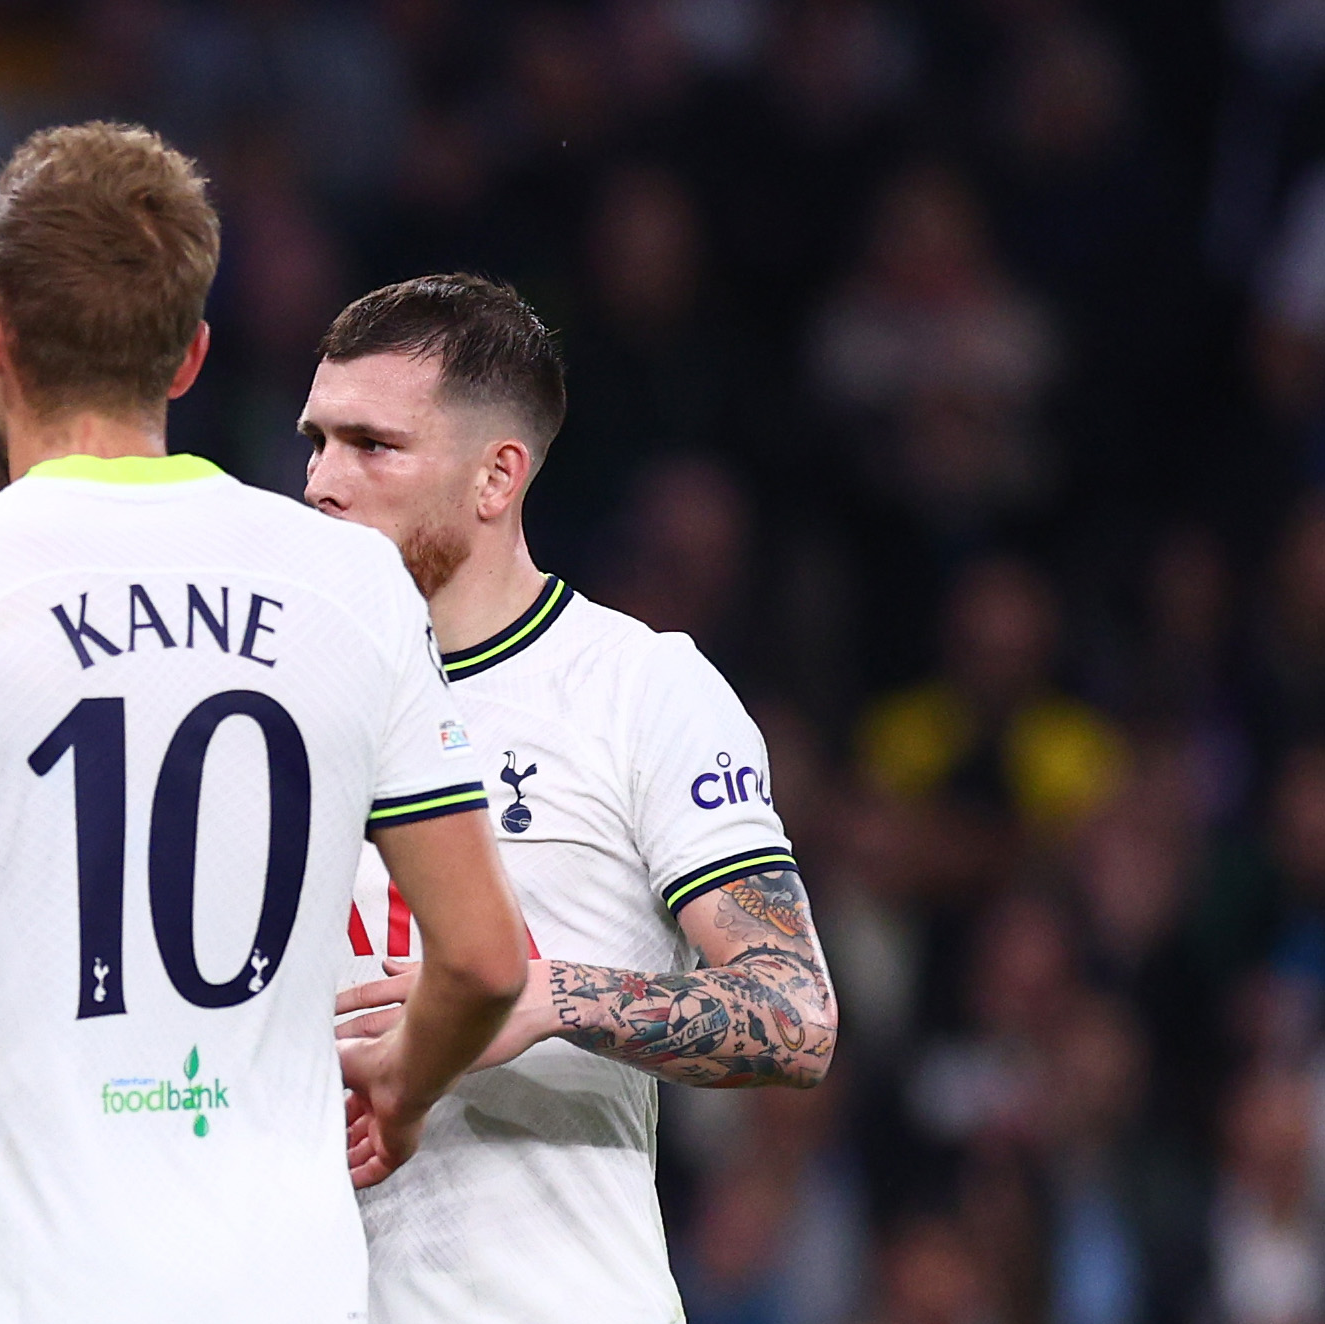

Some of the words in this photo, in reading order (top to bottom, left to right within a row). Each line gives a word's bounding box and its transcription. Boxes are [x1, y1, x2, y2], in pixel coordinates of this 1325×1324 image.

[51, 583, 284, 670] KANE
[27, 689, 312, 1020] 10
[102, 1078, 230, 1115] foodbank
